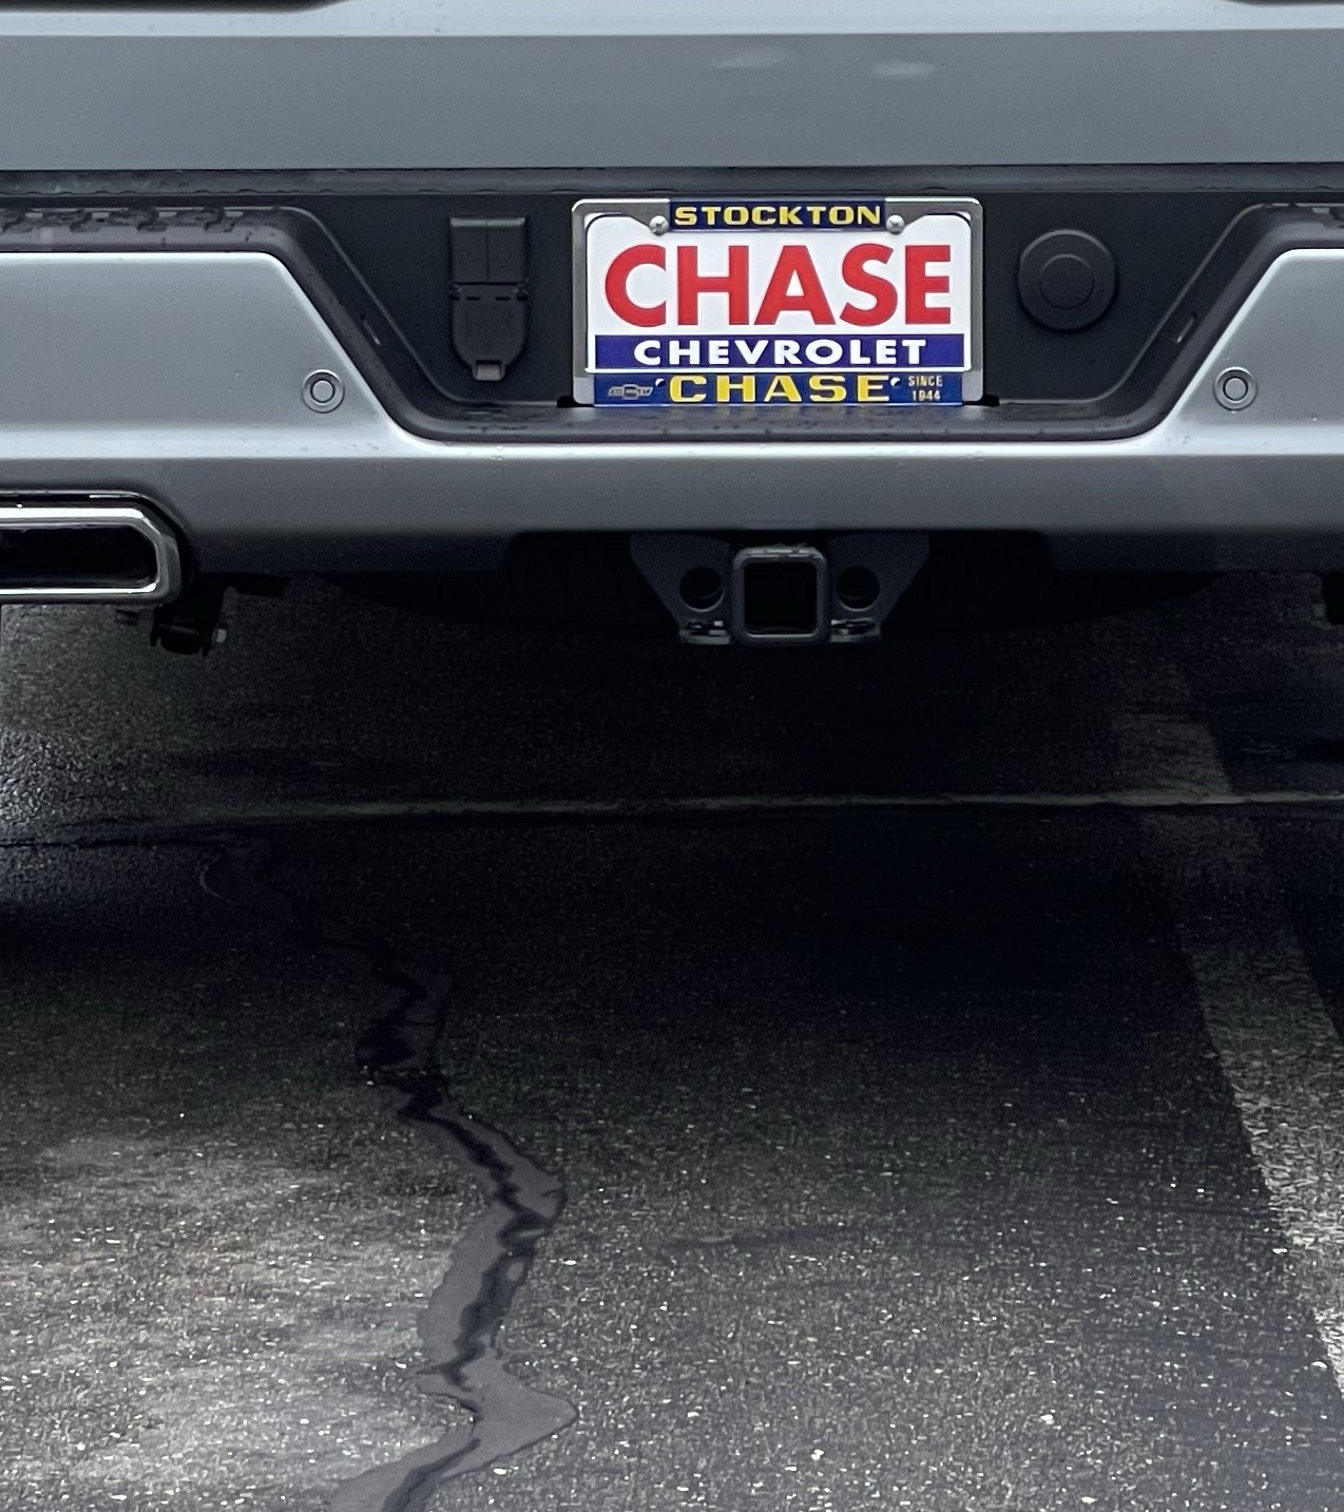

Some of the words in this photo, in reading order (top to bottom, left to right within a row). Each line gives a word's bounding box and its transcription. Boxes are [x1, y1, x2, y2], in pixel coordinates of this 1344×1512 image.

[674, 205, 881, 225] STOCKTON
[604, 243, 951, 327] CHASE
[634, 339, 927, 366] CHEVROLET
[670, 375, 890, 403] CHASE
[908, 375, 943, 387] SINCE
